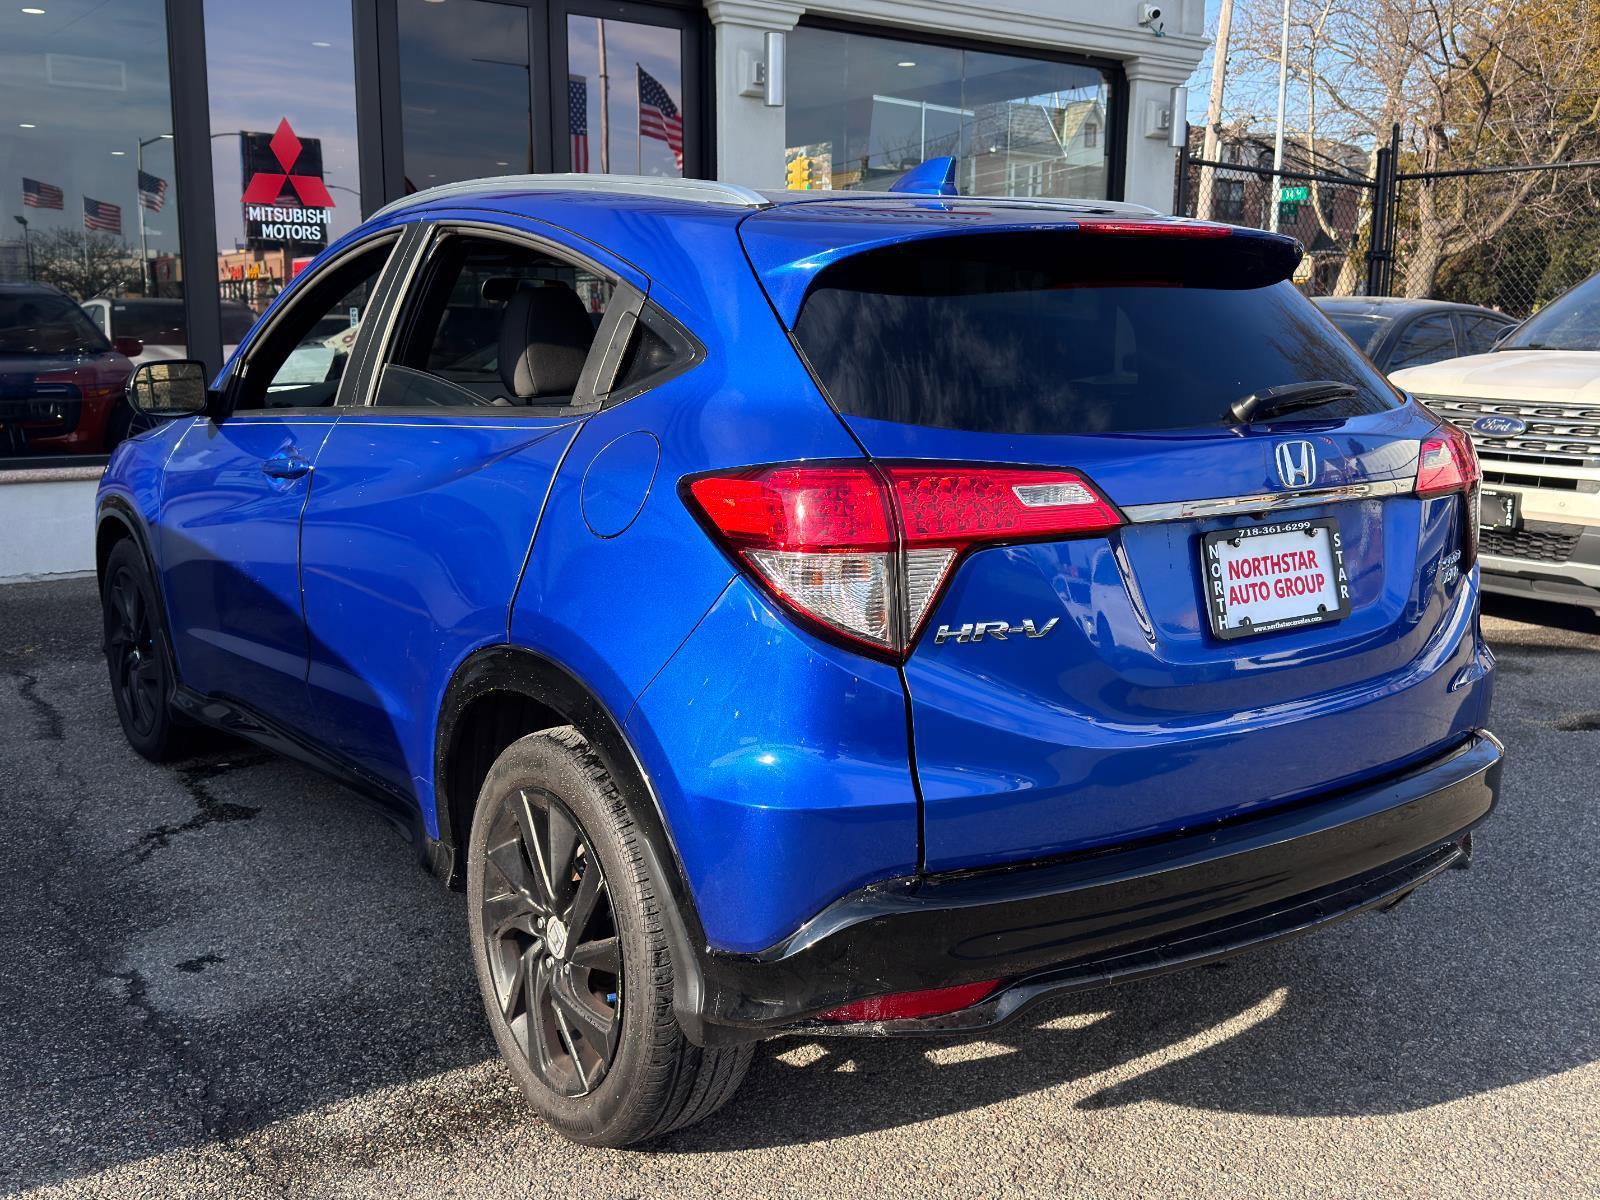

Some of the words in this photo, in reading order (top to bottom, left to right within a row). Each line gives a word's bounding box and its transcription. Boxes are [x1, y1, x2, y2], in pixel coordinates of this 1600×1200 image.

[248, 206, 331, 224] MITSUBISHI
[261, 224, 321, 240] MOTORS
[1481, 418, 1512, 432] Ford
[1505, 498, 1513, 527] STAR
[1238, 521, 1311, 537] 718-361-6299
[1228, 549, 1319, 580] NORTHSTAR
[1333, 532, 1350, 599] STAR
[1208, 544, 1229, 630] NORTH
[1229, 581, 1271, 606] AUTO
[1273, 572, 1325, 599] GROUP
[934, 617, 1060, 644] HR-V
